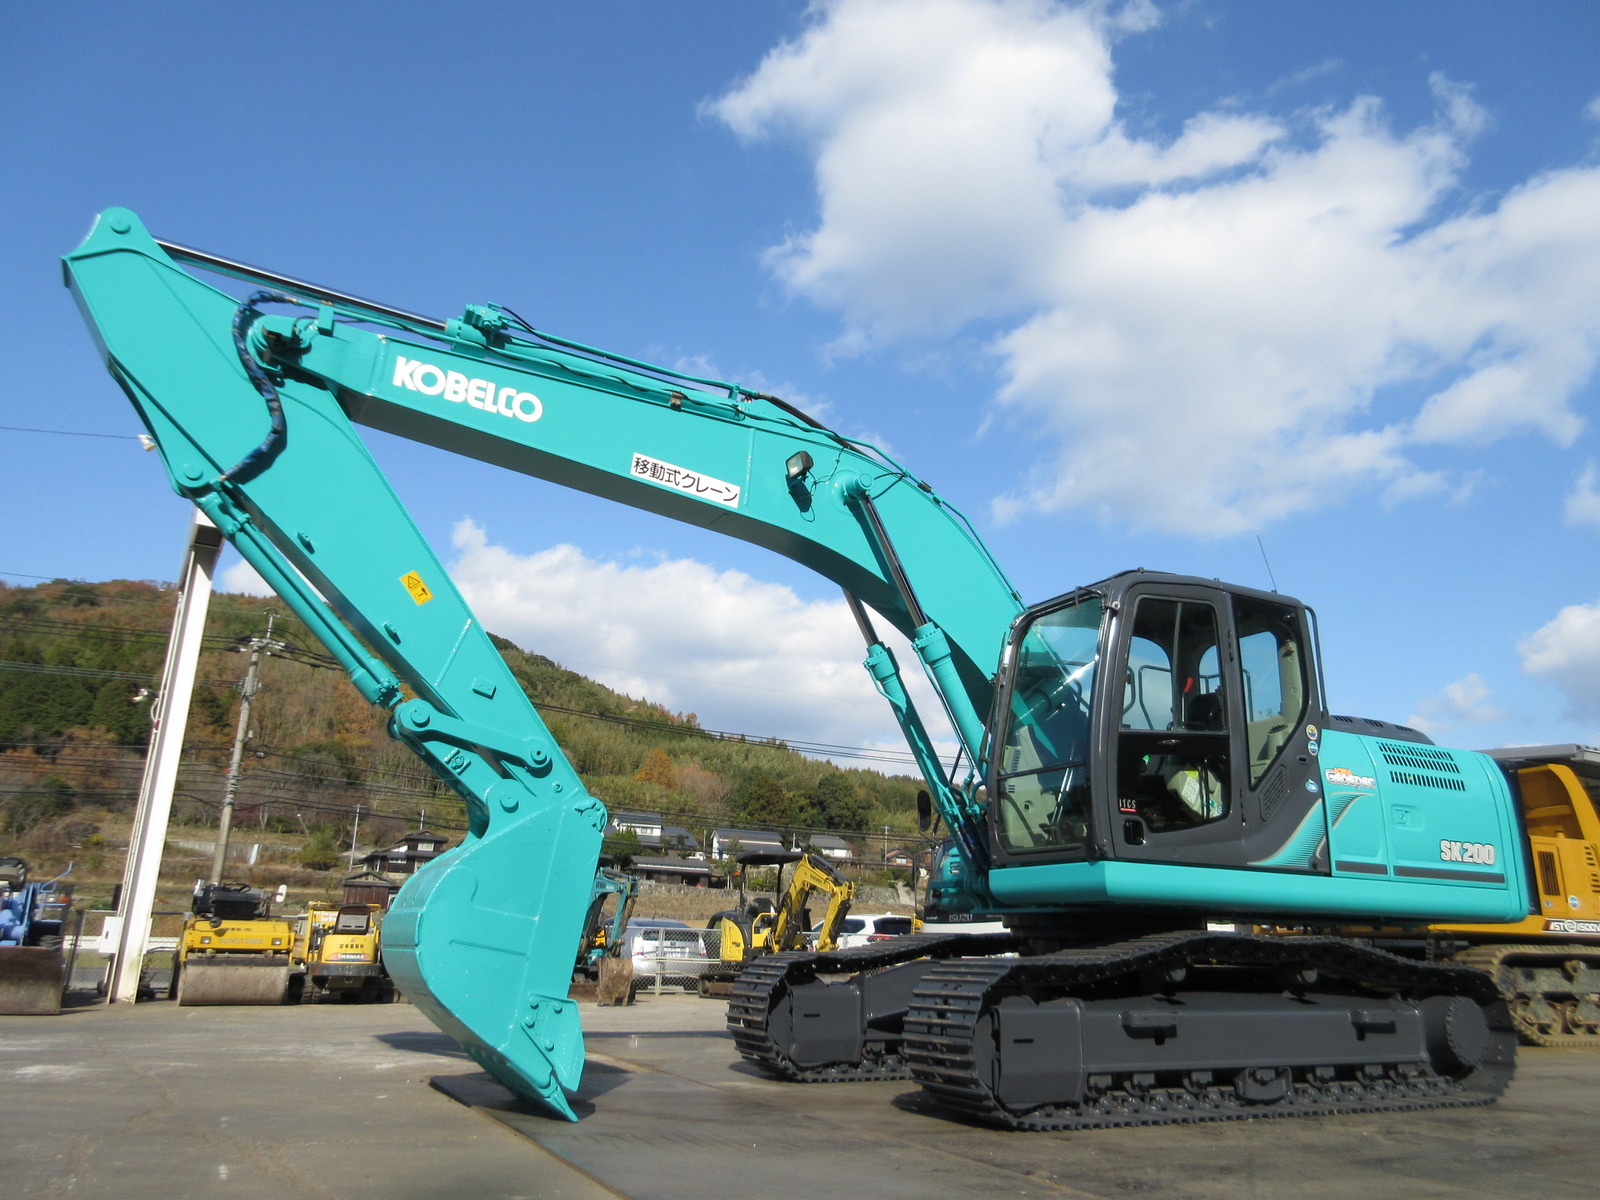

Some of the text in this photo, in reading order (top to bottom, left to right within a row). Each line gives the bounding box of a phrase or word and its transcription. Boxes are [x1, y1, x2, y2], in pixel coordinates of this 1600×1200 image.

[392, 355, 543, 423] KOBELCO
[633, 457, 738, 502] 移動式クレーン
[949, 914, 973, 922] ISUZU
